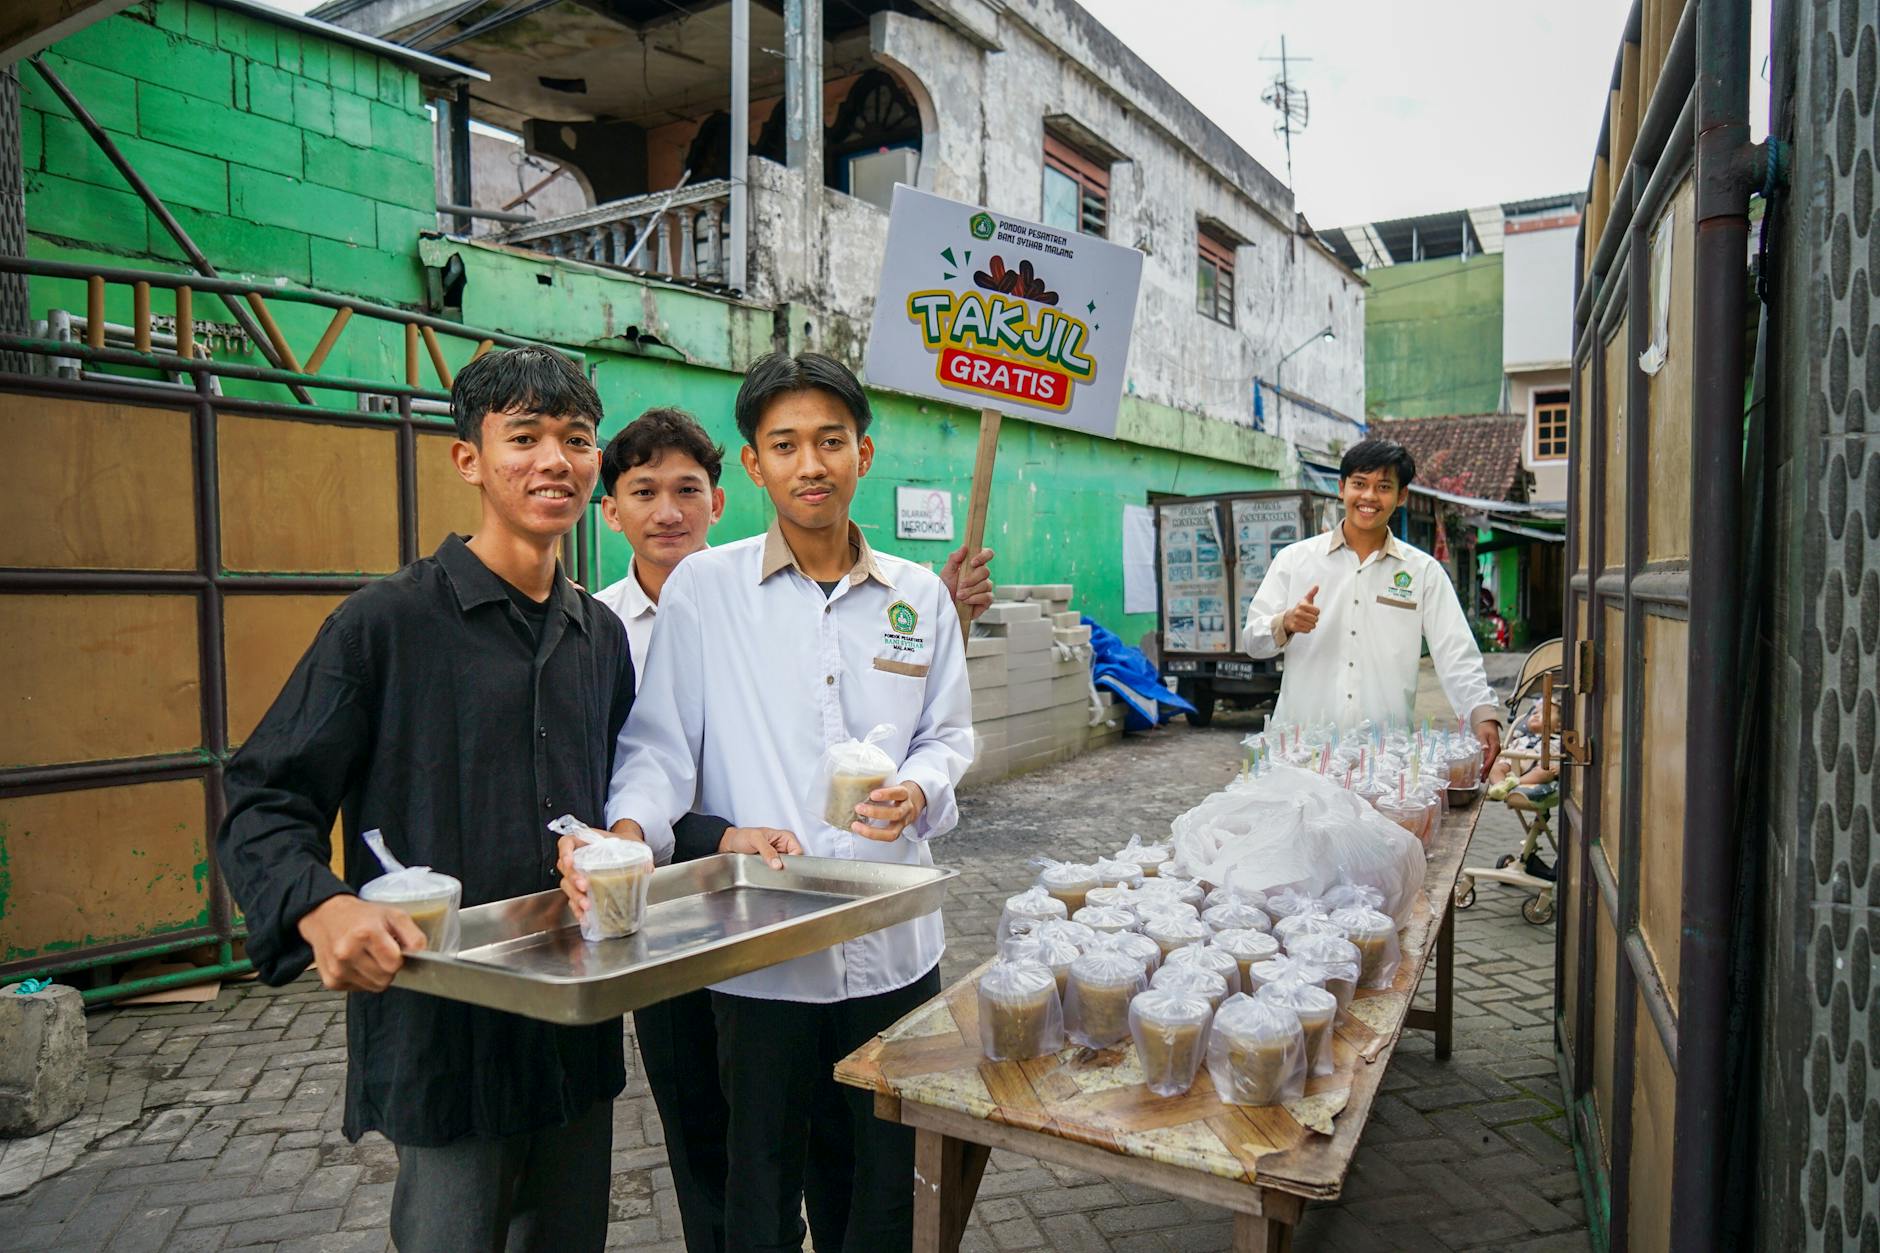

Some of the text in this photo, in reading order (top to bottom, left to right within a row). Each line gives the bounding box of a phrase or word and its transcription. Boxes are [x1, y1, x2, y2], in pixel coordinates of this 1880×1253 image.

[997, 232, 1074, 259] BANI SYIHAB MALANG
[1000, 220, 1067, 246] PONDOK PESANTREN
[911, 294, 1091, 376] TAKJIL
[950, 355, 1056, 399] GRATIS
